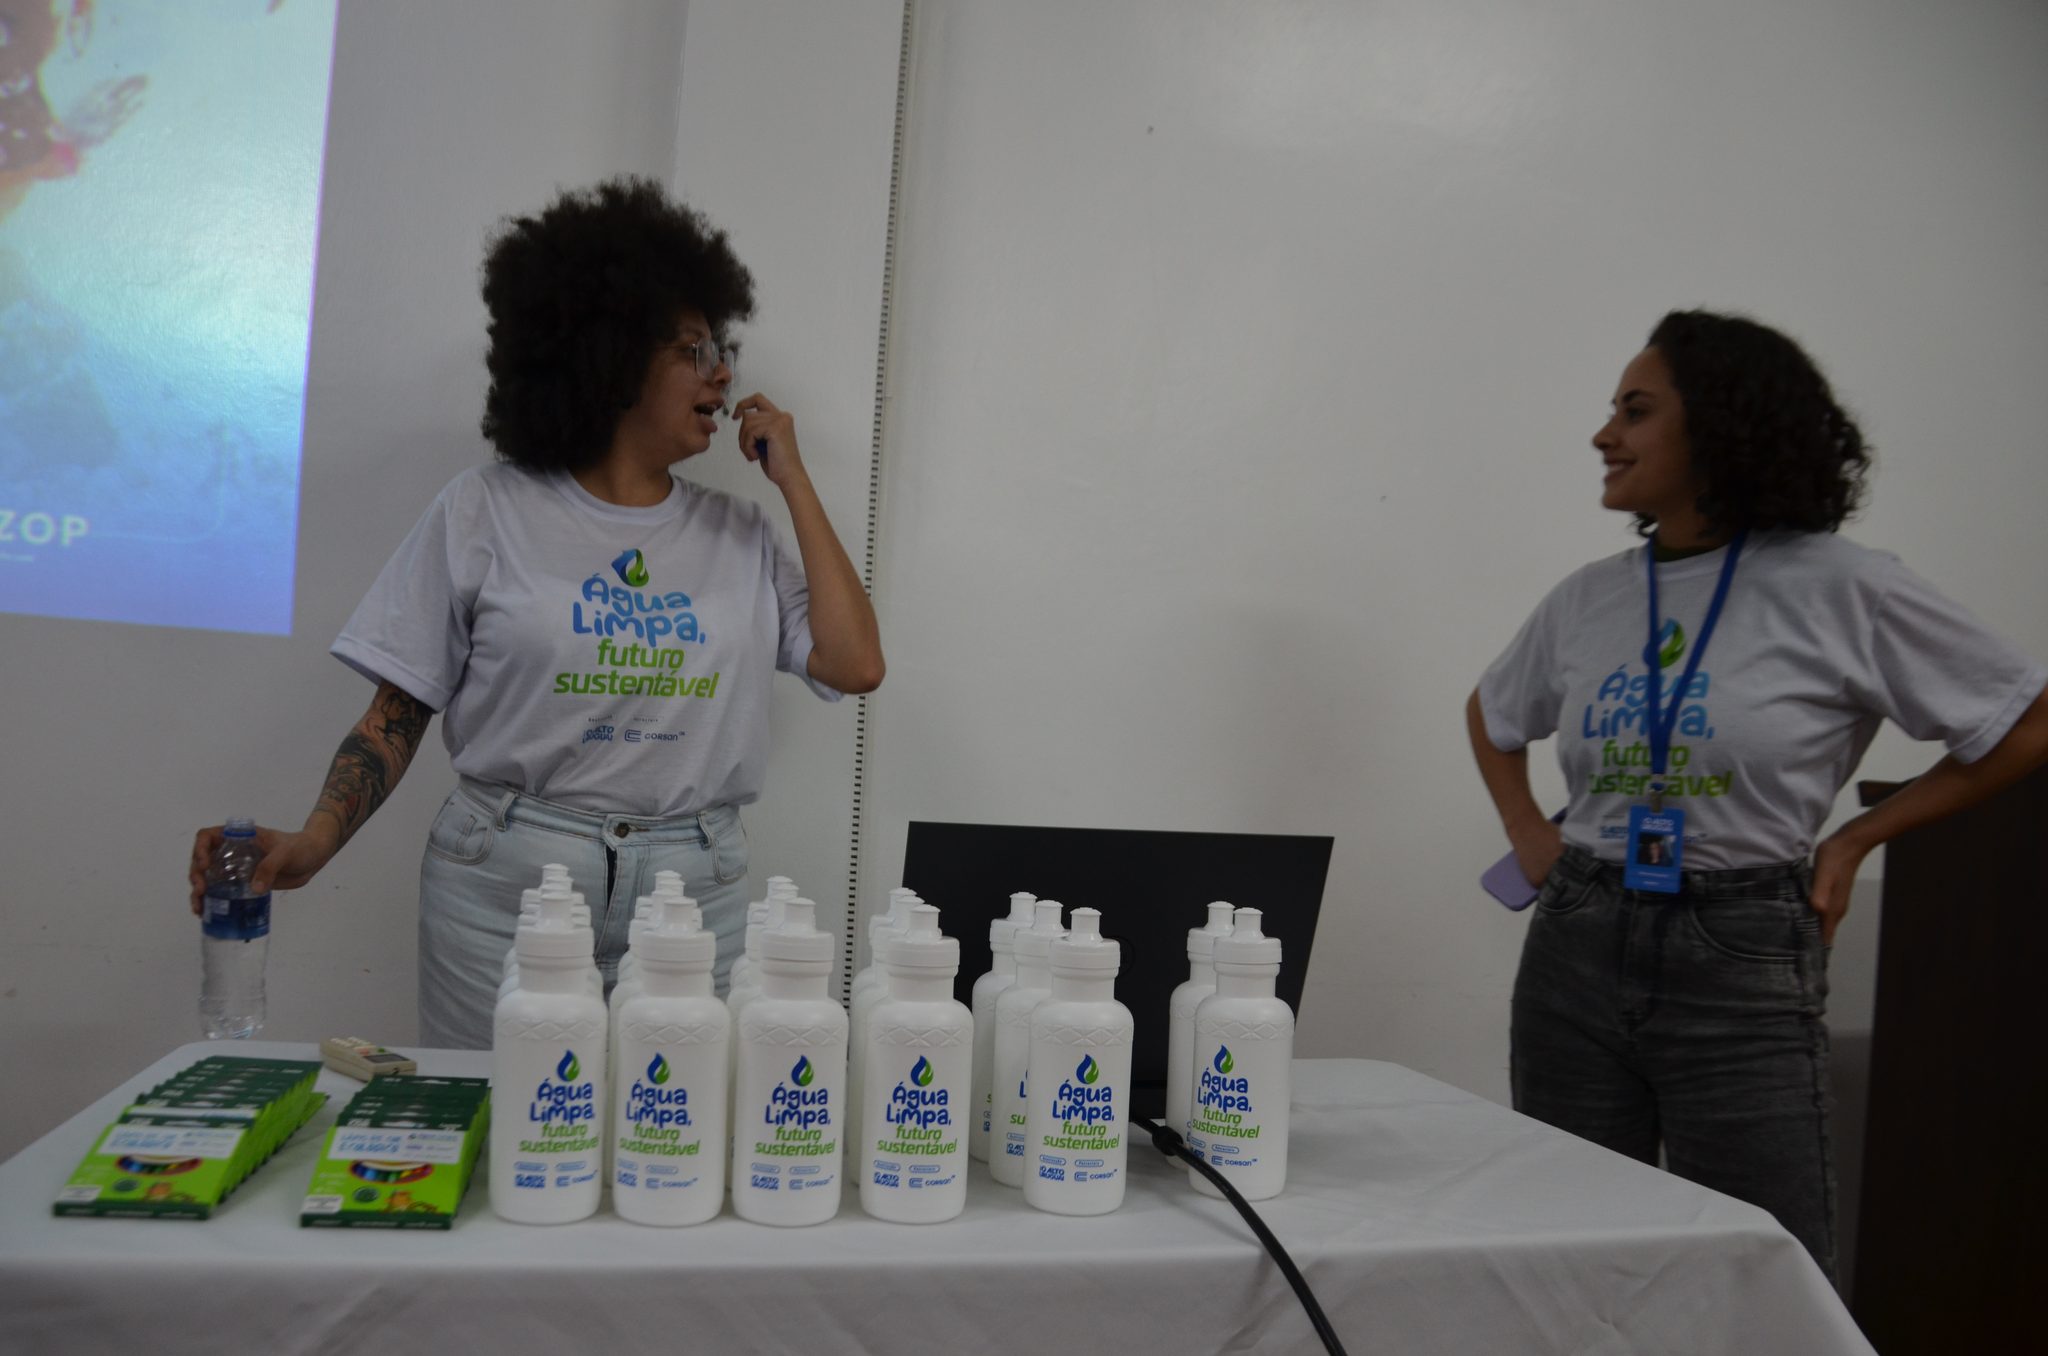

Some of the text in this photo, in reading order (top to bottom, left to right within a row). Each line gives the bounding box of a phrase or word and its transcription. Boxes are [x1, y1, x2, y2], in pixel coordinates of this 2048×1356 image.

[582, 573, 691, 616] Água
[573, 602, 706, 647] Limpa,
[598, 639, 685, 669] futuro
[553, 671, 720, 698] sustentável
[1583, 704, 1715, 740] Lima,
[537, 1077, 593, 1106] Água
[631, 1079, 687, 1108] Água
[1059, 1079, 1112, 1106] Água
[1201, 1067, 1249, 1094] Água
[772, 1082, 828, 1110] Água
[893, 1082, 948, 1110] Água
[1197, 1086, 1252, 1113] Limpa,
[626, 1101, 692, 1129] Limpa,
[765, 1105, 831, 1130] Limpa,
[886, 1103, 952, 1130] Limpa,
[1052, 1100, 1114, 1126] Limpa,
[1203, 1107, 1242, 1124] futuro
[542, 1123, 588, 1138] futuro
[634, 1123, 681, 1142] futuro
[776, 1126, 822, 1141] futuro
[896, 1125, 942, 1140] futuro
[1043, 1133, 1120, 1150] sustentável
[1062, 1121, 1107, 1136] futuro
[1192, 1118, 1261, 1139] sustentável
[619, 1137, 701, 1156] sustentável
[755, 1139, 836, 1156] sustentável
[877, 1139, 957, 1155] sustentável
